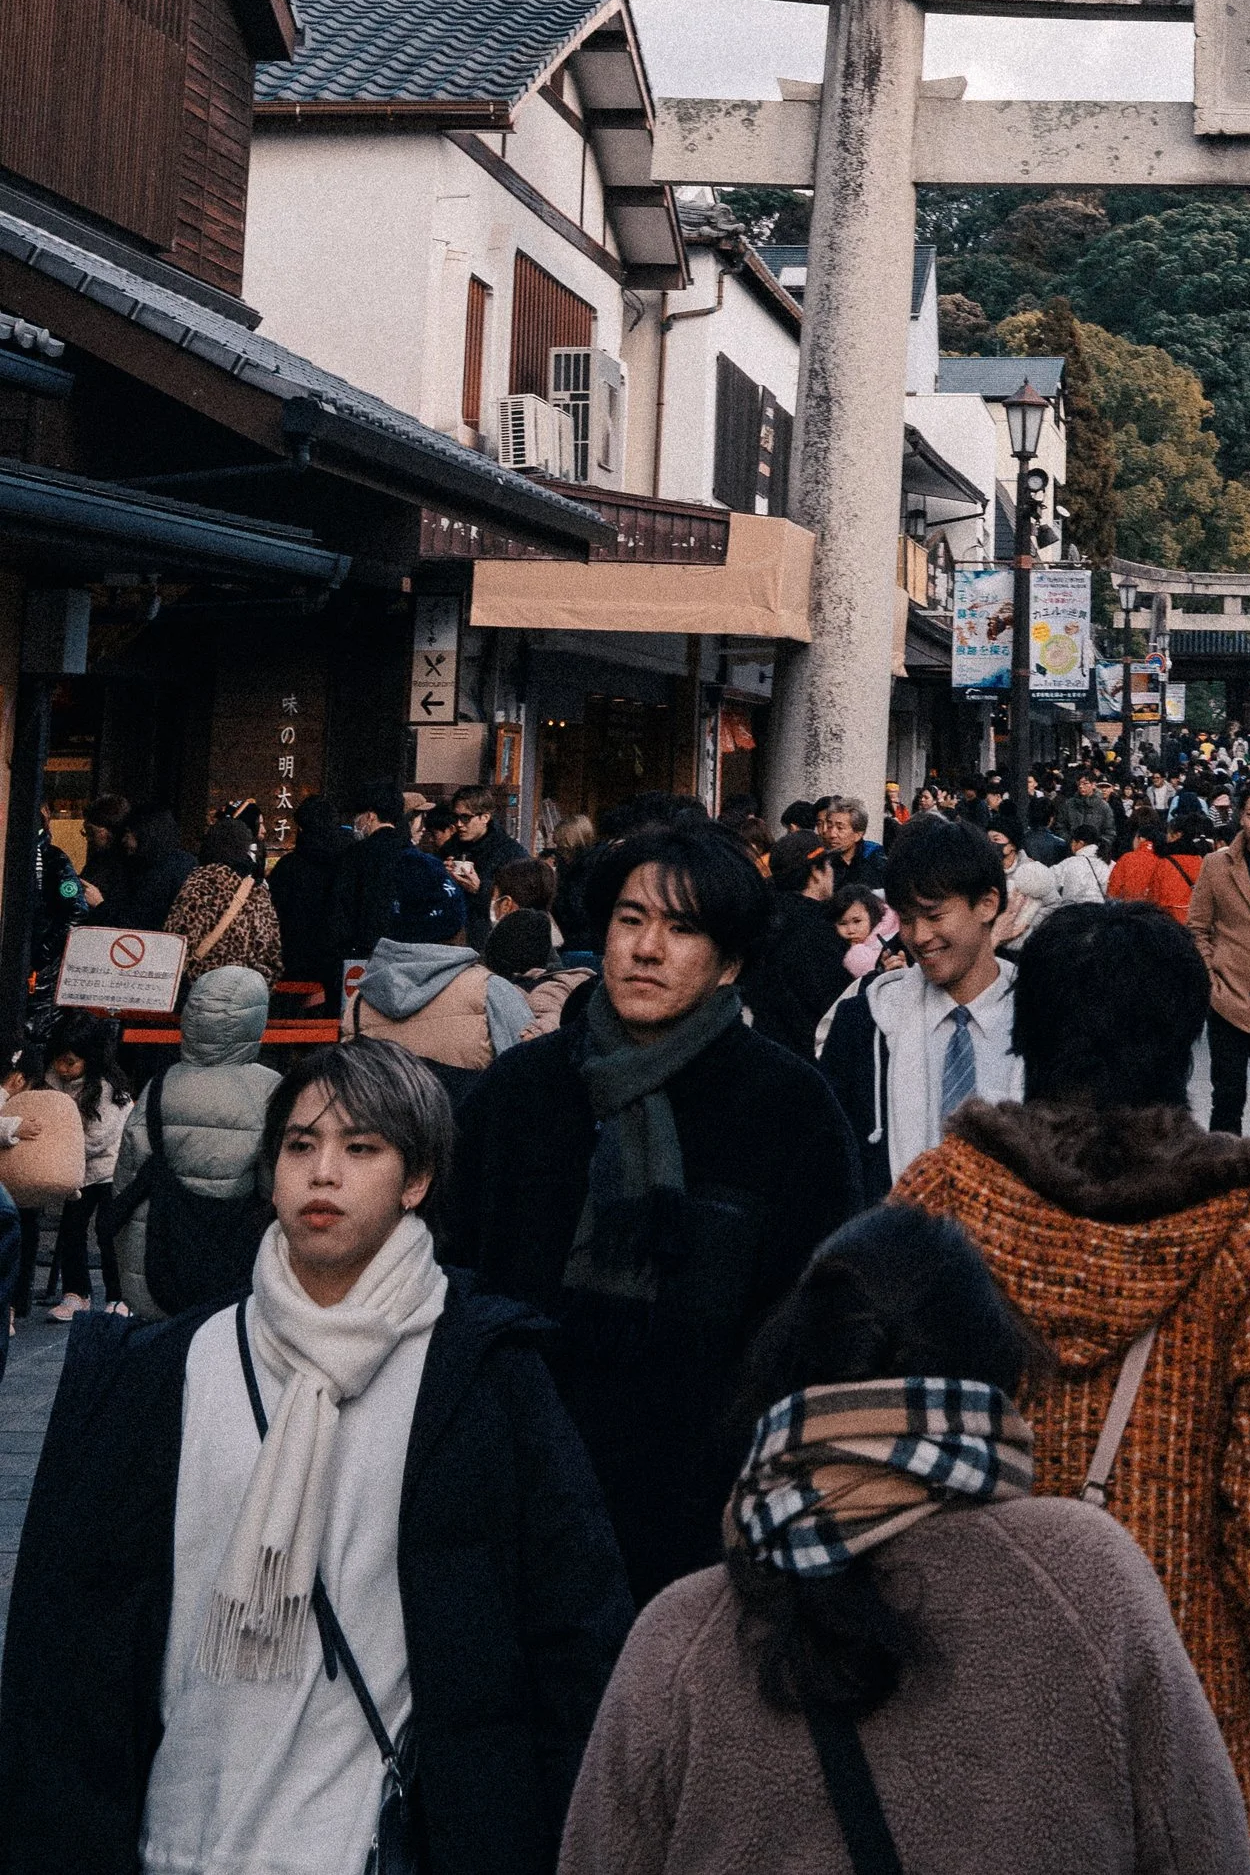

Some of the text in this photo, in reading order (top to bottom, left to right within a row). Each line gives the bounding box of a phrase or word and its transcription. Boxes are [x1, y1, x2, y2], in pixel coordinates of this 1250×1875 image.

[274, 693, 299, 842] 味の明太子
